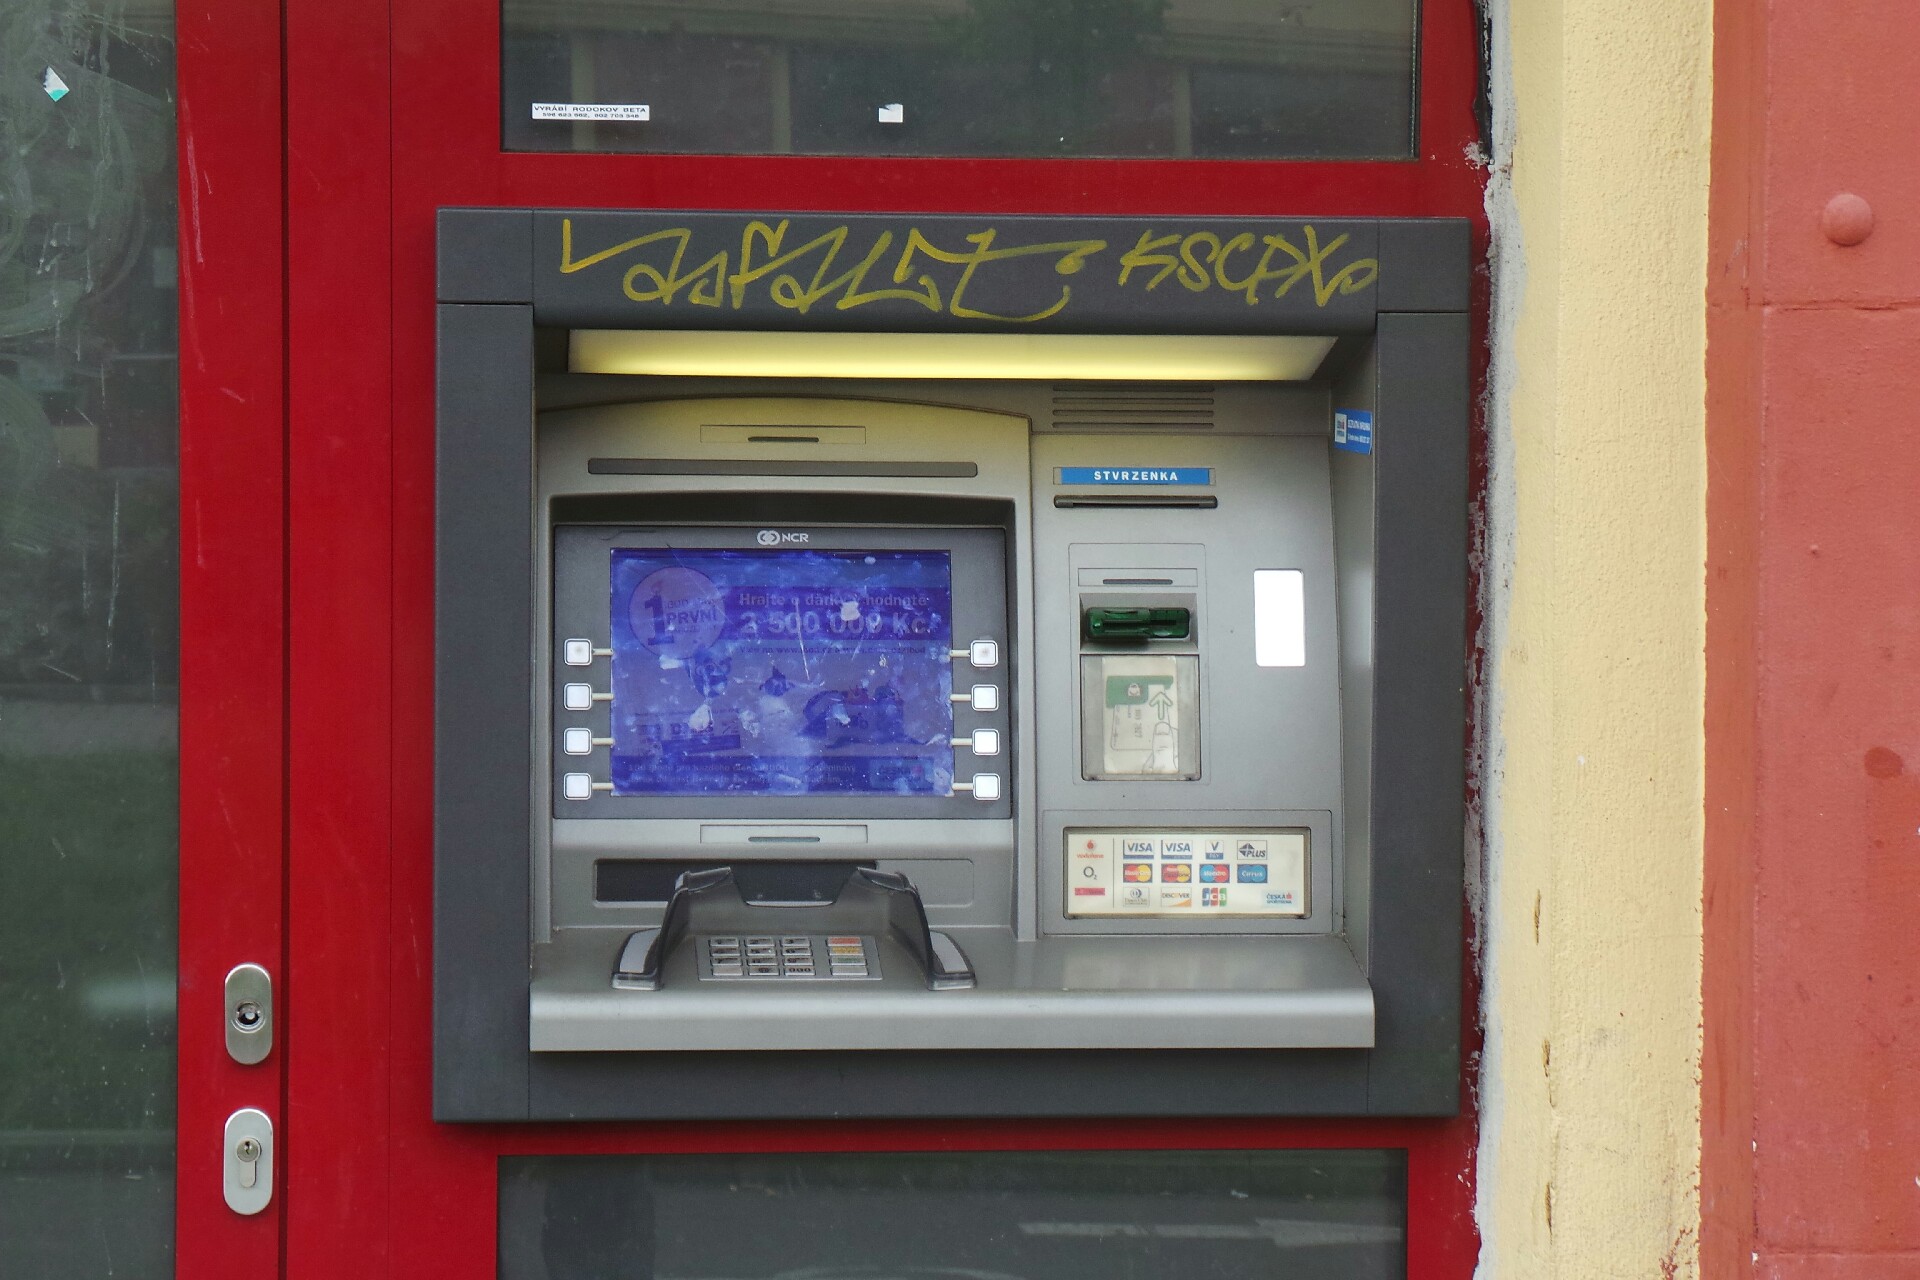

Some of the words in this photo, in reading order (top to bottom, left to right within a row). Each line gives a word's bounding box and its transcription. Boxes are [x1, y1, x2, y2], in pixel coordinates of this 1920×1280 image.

[1093, 470, 1178, 482] STVRZENKA
[781, 532, 809, 543] NCR
[738, 593, 786, 608] Hrajte
[864, 592, 928, 607] hodnotě
[739, 611, 758, 634] 2
[767, 611, 821, 635] 500
[829, 612, 884, 635] 000
[1127, 842, 1153, 852] VISA
[1165, 842, 1191, 852] VISA
[1210, 841, 1220, 851] V
[1246, 850, 1267, 858] PLUS
[1241, 870, 1264, 878] Cirrus
